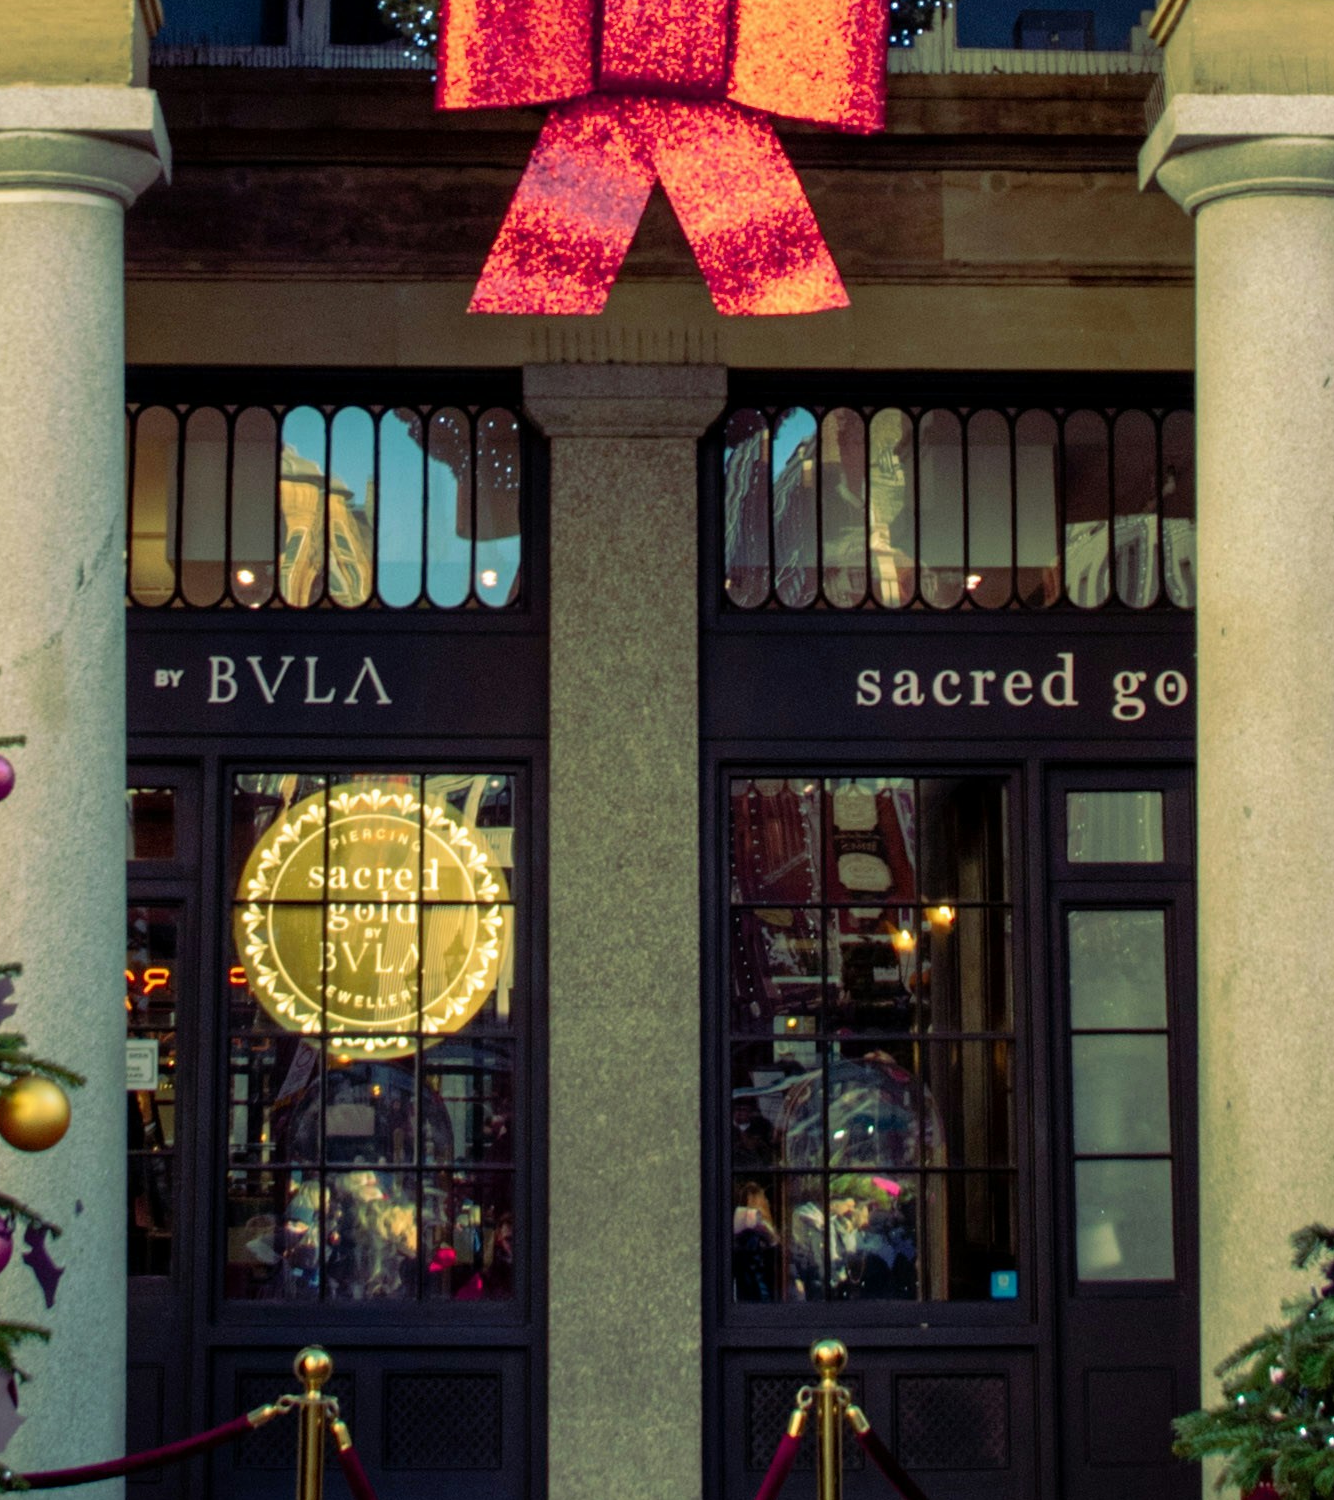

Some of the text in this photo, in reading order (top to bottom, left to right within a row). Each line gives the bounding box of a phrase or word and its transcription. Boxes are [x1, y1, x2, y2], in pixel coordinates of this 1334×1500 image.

[154, 669, 183, 687] BY
[856, 652, 1197, 721] sacred go
[329, 827, 421, 852] PIERCING
[308, 858, 439, 891] sacred
[327, 891, 417, 931] gold
[364, 927, 382, 939] BY
